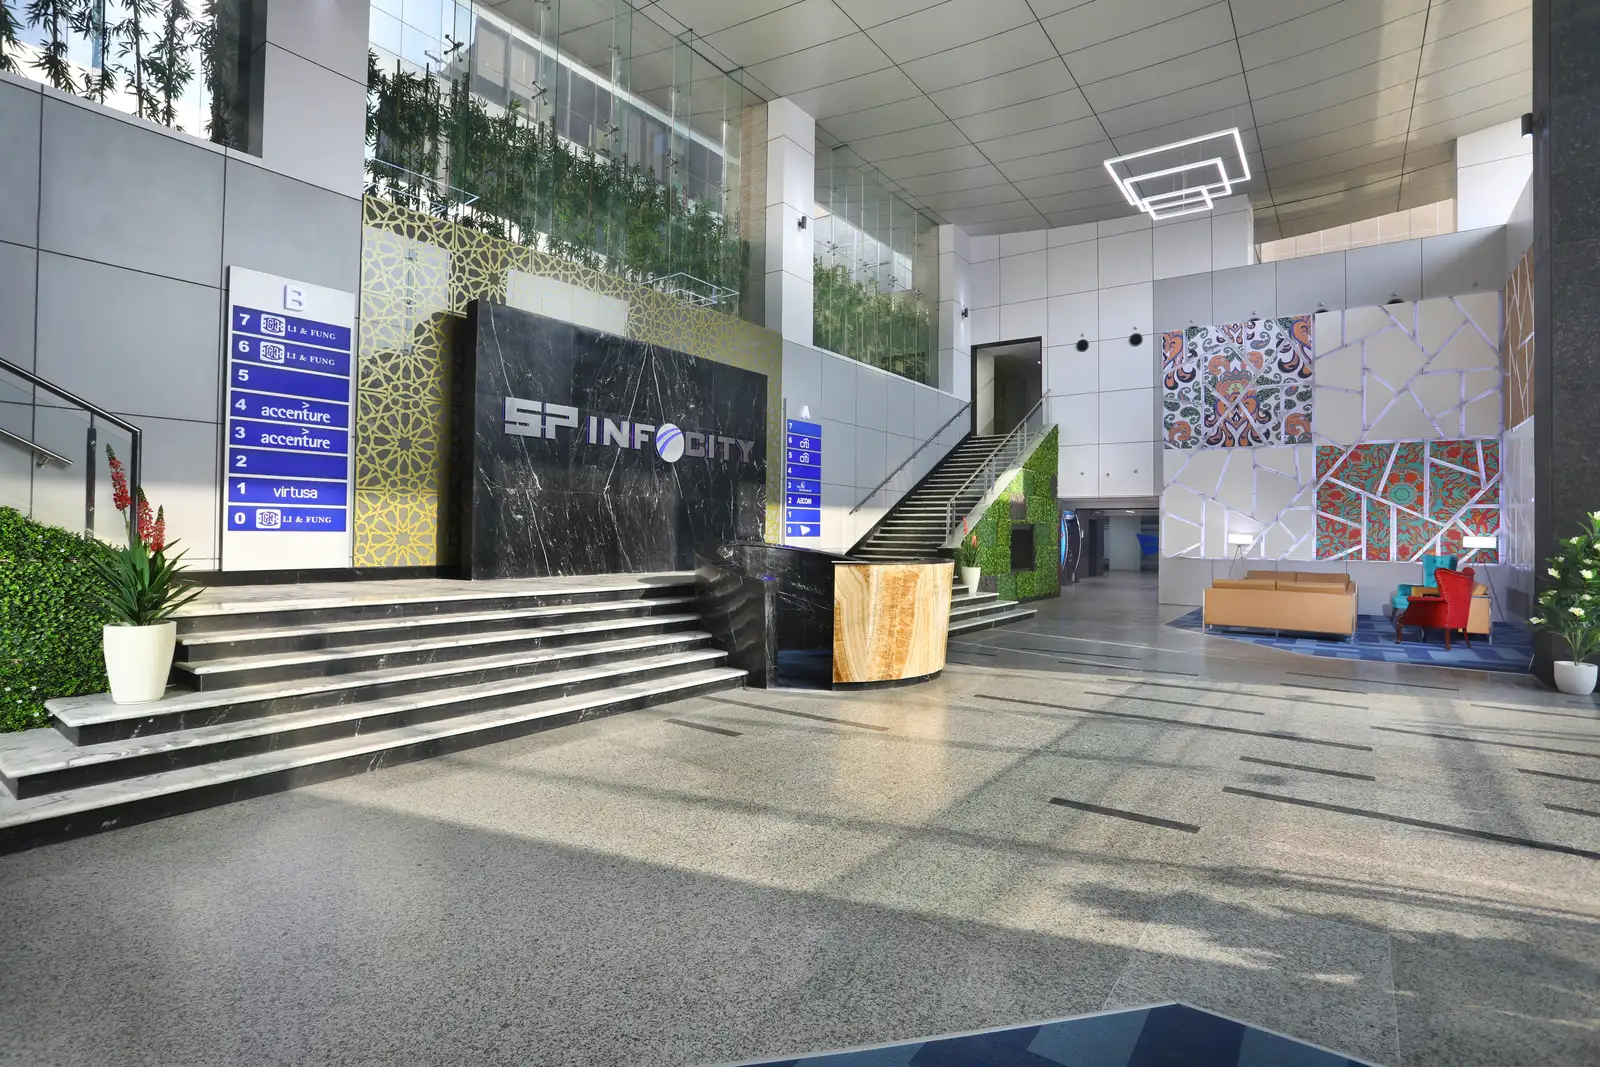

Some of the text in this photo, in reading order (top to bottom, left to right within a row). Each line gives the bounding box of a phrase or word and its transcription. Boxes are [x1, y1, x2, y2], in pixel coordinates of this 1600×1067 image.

[284, 284, 305, 312] B
[239, 313, 250, 326] 7
[287, 325, 297, 333] LI
[310, 329, 336, 340] FUNG
[238, 340, 250, 353] 6
[286, 352, 296, 360] LI
[309, 355, 335, 366] FUNG
[238, 369, 249, 382] 5
[235, 398, 331, 423] 4 accenture
[502, 396, 579, 440] SP
[800, 405, 811, 419] A
[234, 426, 331, 449] 3 accenture
[235, 455, 247, 467] 2
[236, 482, 318, 499] 1 virtusa
[787, 496, 793, 504] 2
[234, 512, 246, 525] 0
[282, 515, 292, 523] LI
[306, 516, 332, 524] FUNG
